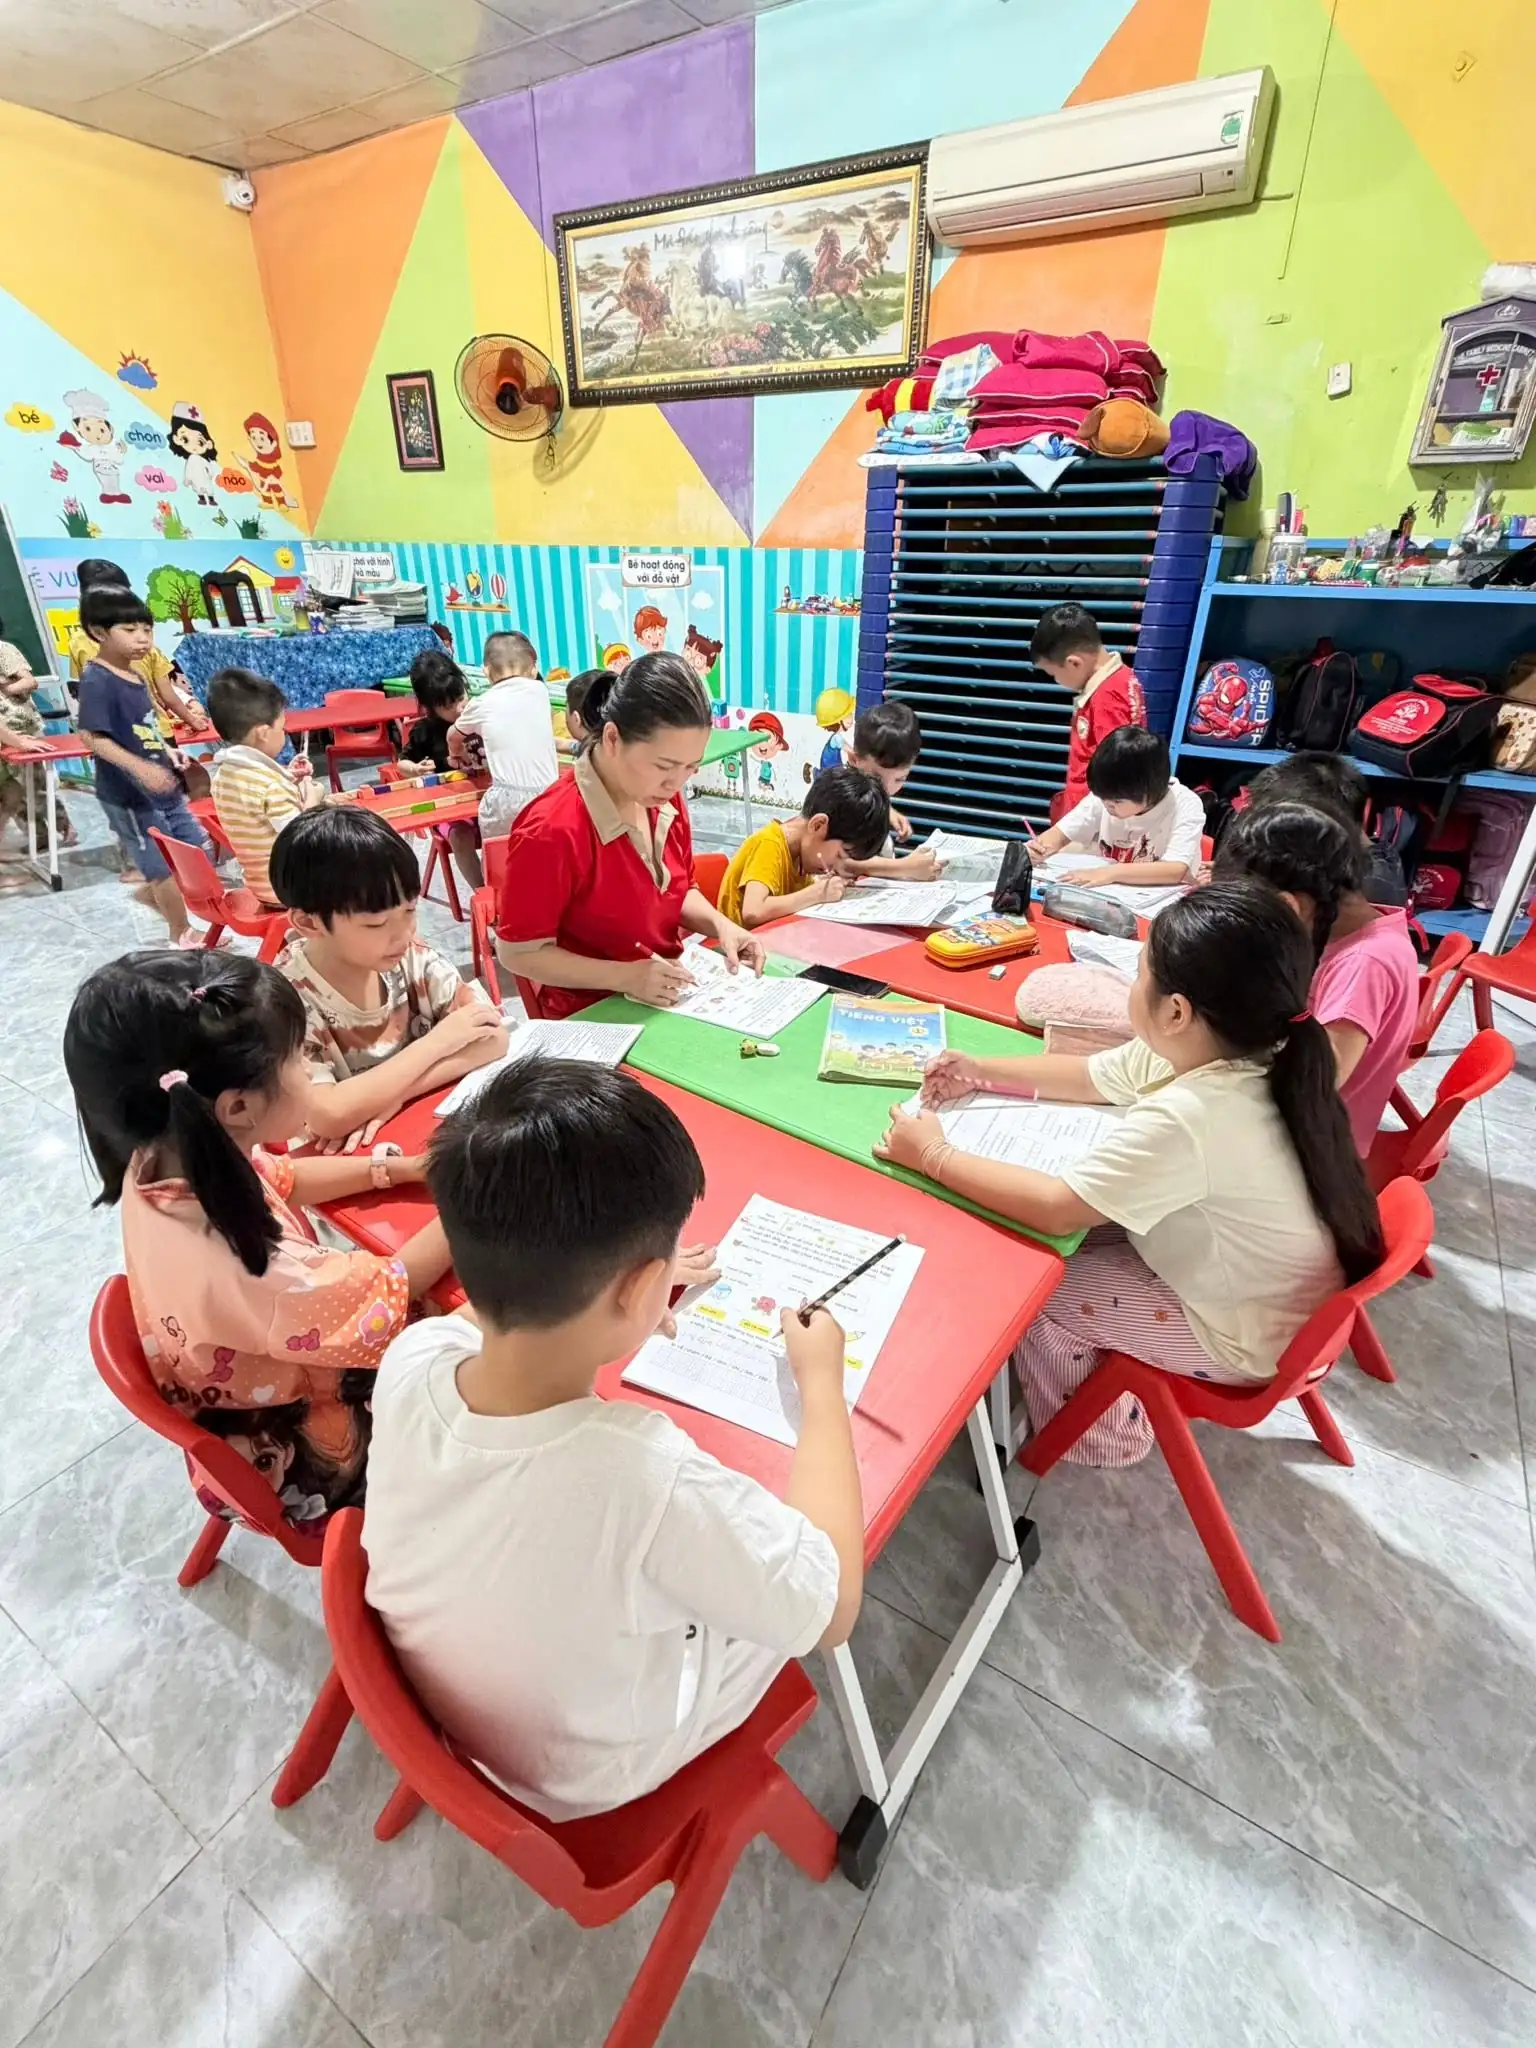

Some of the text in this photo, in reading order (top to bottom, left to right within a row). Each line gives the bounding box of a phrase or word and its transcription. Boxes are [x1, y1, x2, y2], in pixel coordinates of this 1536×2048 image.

[18, 409, 41, 424] bé
[627, 559, 639, 569] Bé
[48, 570, 78, 588] VU
